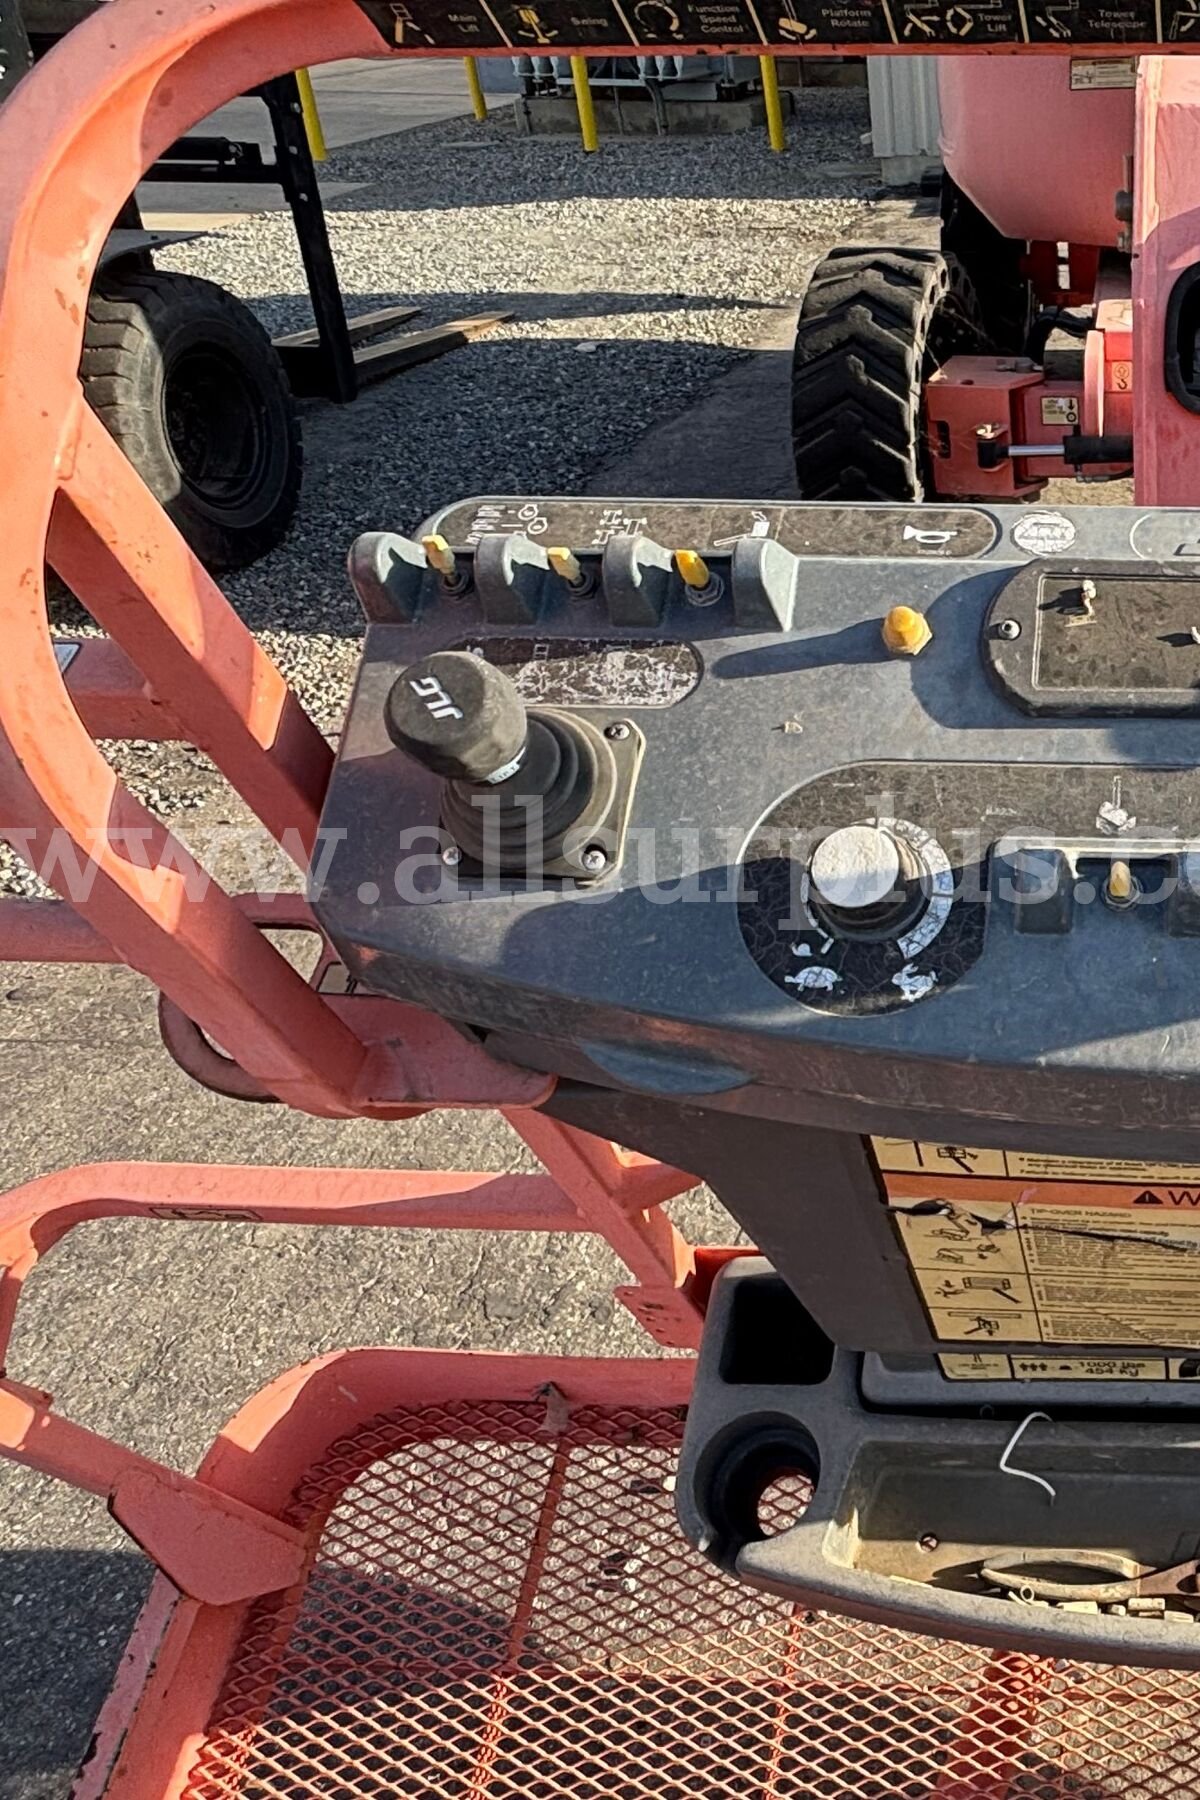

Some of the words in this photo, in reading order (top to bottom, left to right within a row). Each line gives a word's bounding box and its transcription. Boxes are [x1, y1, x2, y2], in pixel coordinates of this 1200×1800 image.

[821, 9, 872, 18] Platform
[977, 13, 1012, 21] Tower
[1097, 9, 1136, 18] Tower
[830, 19, 870, 28] Rotate
[1088, 19, 1147, 29] Telescope
[700, 25, 744, 34] Control
[409, 677, 464, 720] JLG
